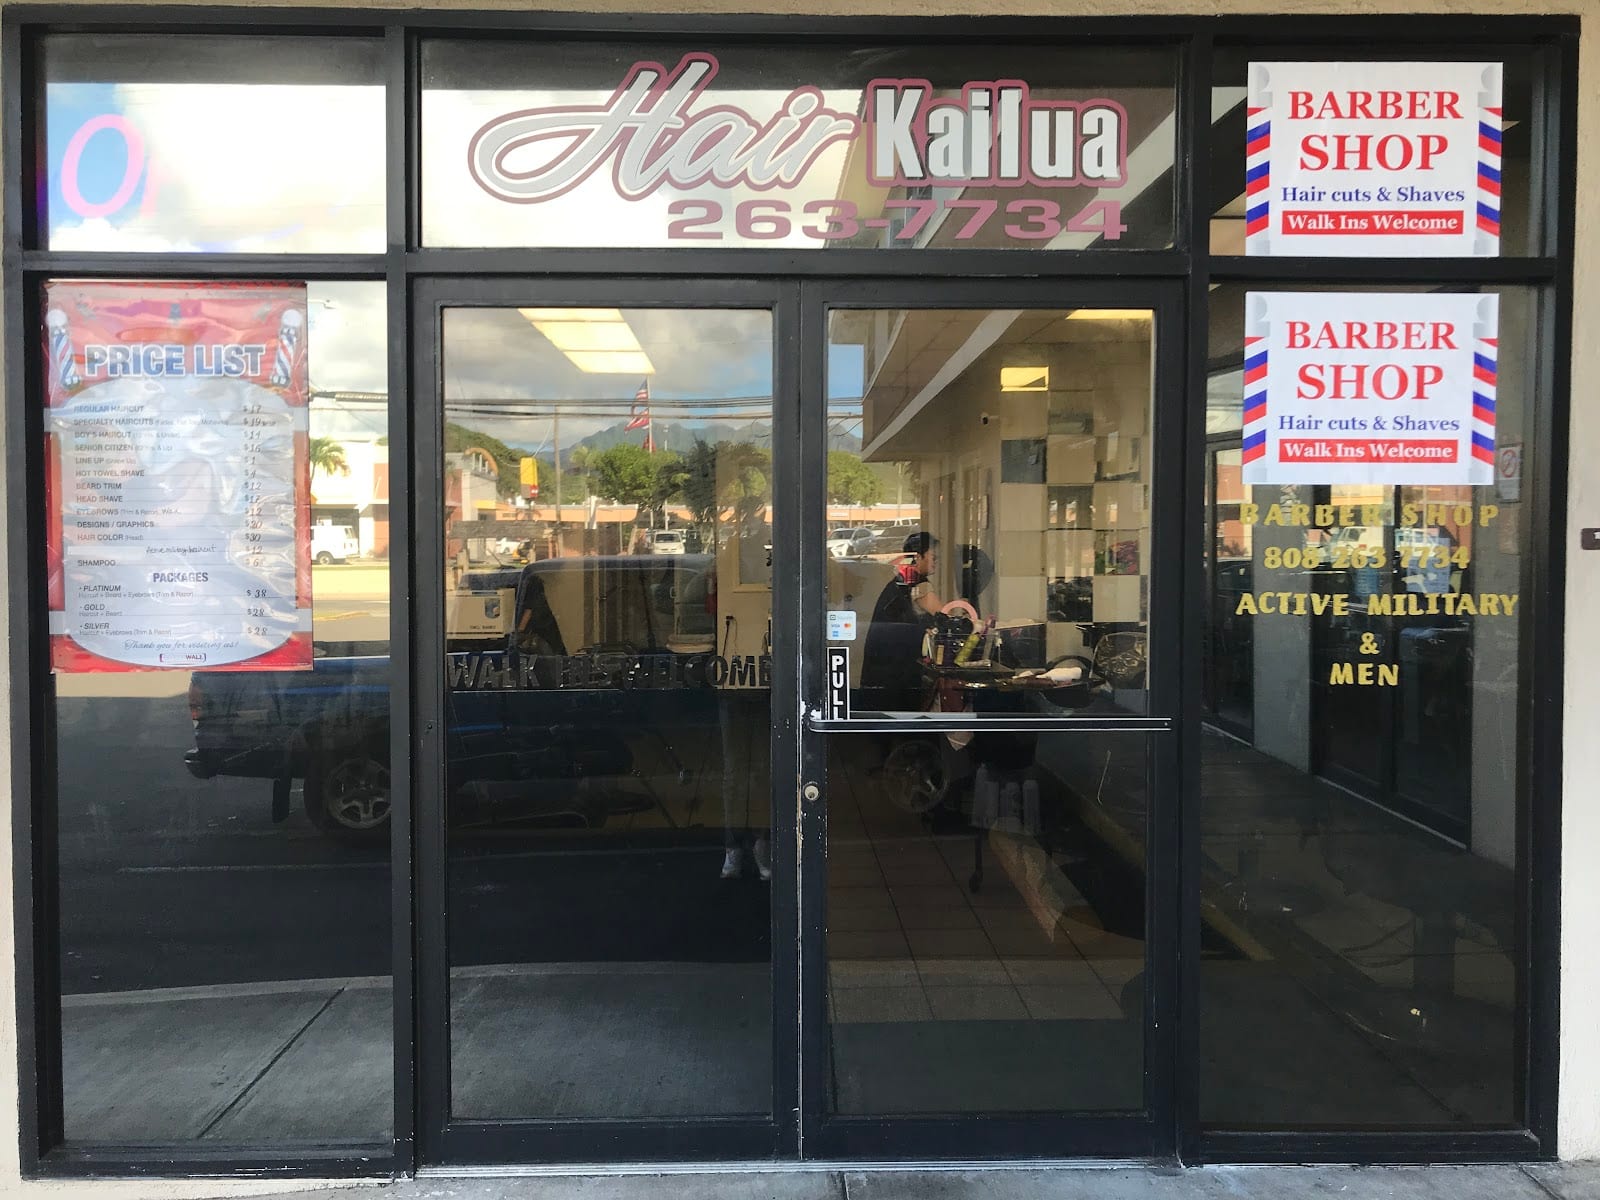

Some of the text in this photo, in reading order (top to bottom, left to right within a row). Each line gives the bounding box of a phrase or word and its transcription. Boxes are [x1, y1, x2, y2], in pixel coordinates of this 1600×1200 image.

[1288, 91, 1464, 119] BARBER
[468, 53, 1127, 200] Hair Kailua
[1300, 134, 1448, 171] SHOP
[1281, 186, 1465, 202] Hair cuts & Shaves
[667, 200, 1127, 239] 263-7734
[1288, 214, 1457, 230] Walk Ins Welcome
[1286, 321, 1459, 349] BARBER
[85, 344, 265, 377] PRICE LIST
[1297, 364, 1443, 400] SHOP
[74, 405, 110, 413] REGULAR
[1279, 415, 1460, 431] Hair cuts & Shaves
[1285, 444, 1452, 458] Walk Ins Welcome
[1239, 503, 1499, 527] BARBER SHOP
[1264, 546, 1470, 569] 808 263 7734
[153, 572, 209, 583] PACKAGES
[1236, 592, 1519, 616] ACTIVE MILITARY
[125, 640, 154, 649] Thank
[157, 642, 171, 650] you
[174, 640, 186, 650] for
[187, 641, 221, 650] visiting
[1359, 632, 1380, 655] &
[448, 655, 540, 688] WALK
[1329, 662, 1399, 686] MEN
